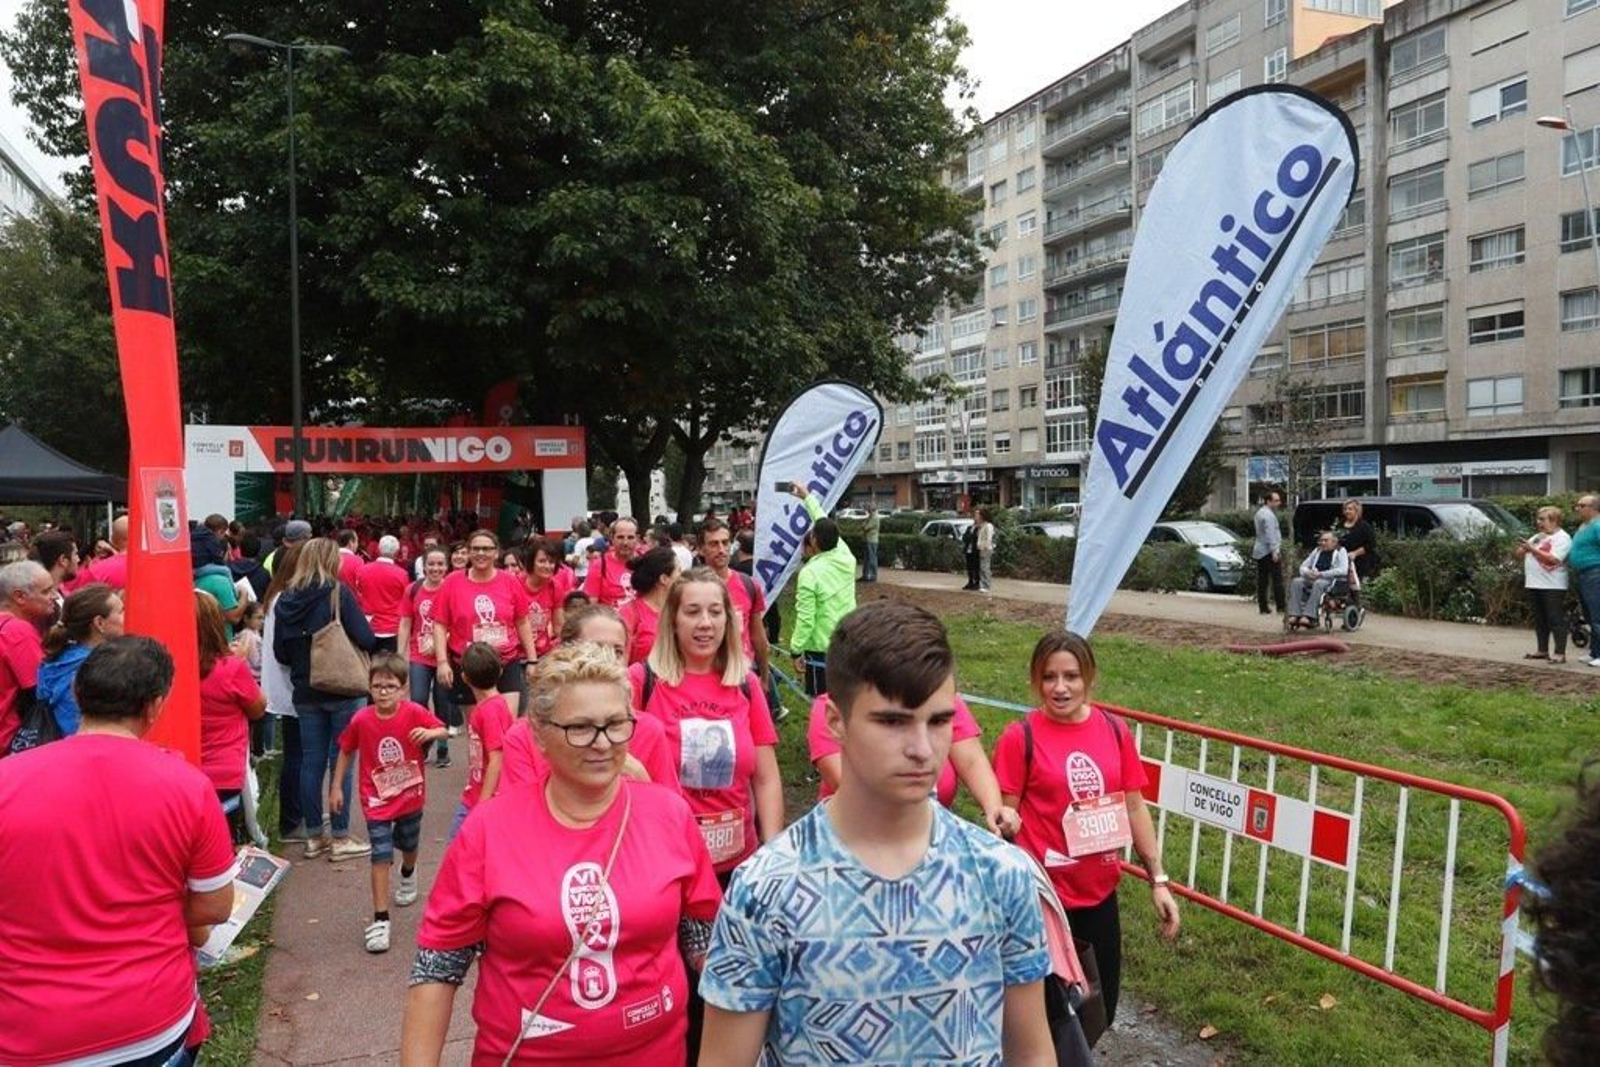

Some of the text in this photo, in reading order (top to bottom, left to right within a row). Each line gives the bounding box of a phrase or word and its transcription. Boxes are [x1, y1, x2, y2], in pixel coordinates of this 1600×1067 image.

[1097, 143, 1323, 490] Atlántico
[1195, 281, 1265, 388] DIARIO
[1189, 782, 1241, 806] CONCELLO
[1194, 797, 1233, 818] DE VIGO
[1079, 811, 1119, 838] 3908
